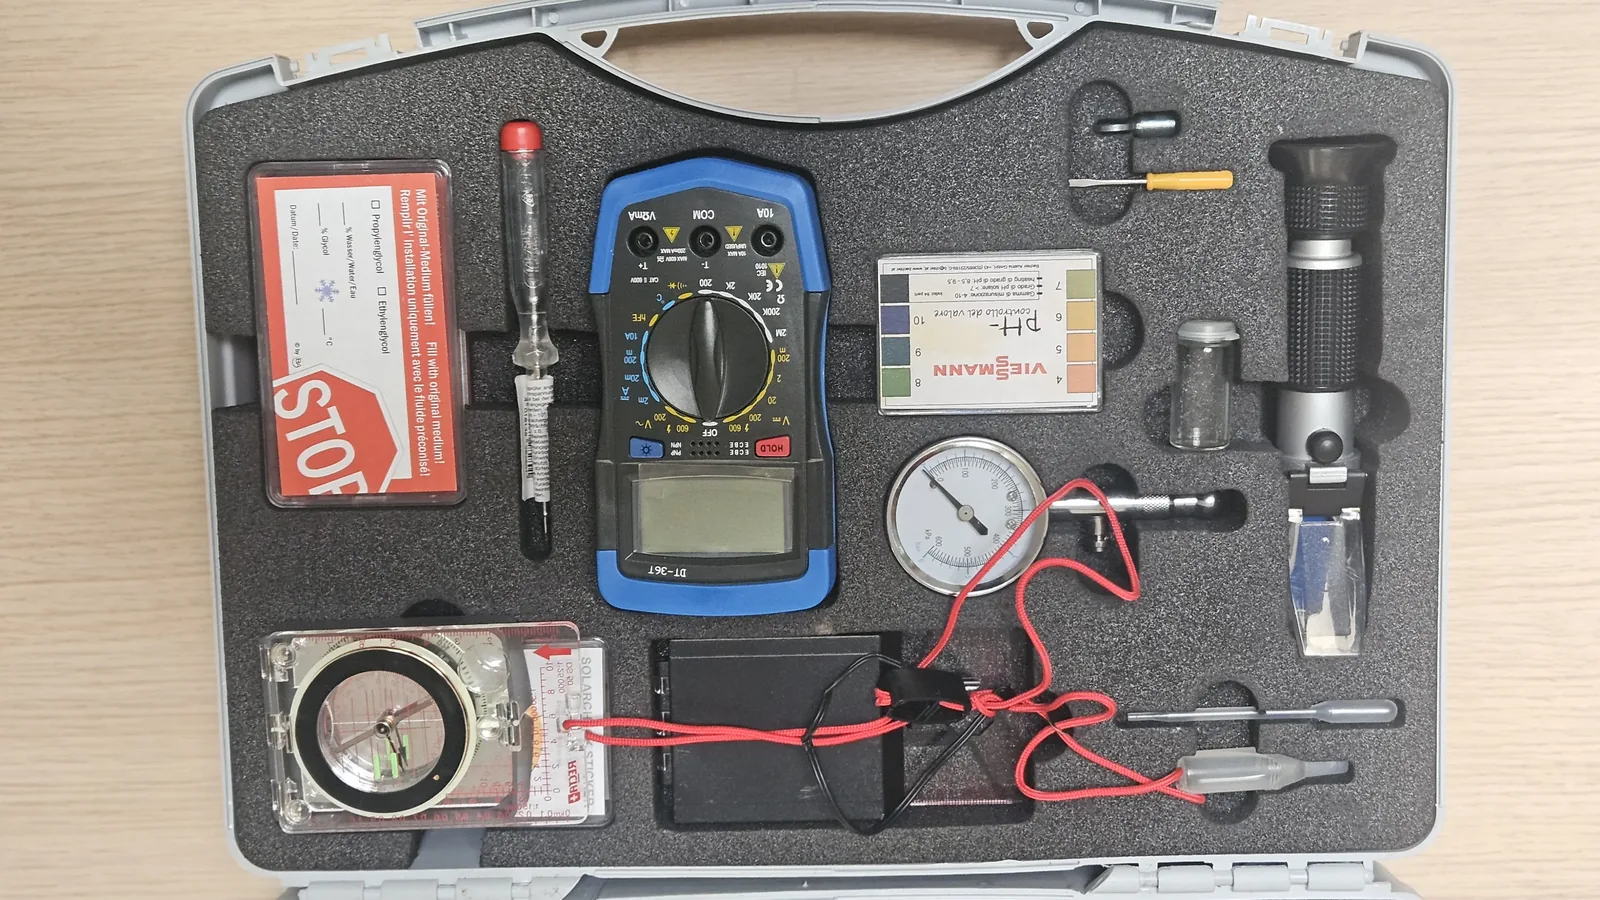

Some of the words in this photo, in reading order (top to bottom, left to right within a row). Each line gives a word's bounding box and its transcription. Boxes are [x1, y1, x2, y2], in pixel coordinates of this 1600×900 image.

[416, 189, 427, 204] Mit
[399, 190, 413, 229] Remplir
[693, 210, 714, 219] COM
[757, 208, 774, 218] 10A
[290, 205, 299, 249] Datum/Date:
[321, 236, 329, 255] Glycol
[372, 215, 384, 274] Propylenglycol
[416, 207, 431, 291] Original-Medium
[346, 235, 357, 298] Wasser/Water/Eau
[403, 240, 418, 295] installation
[1056, 282, 1061, 290] 7
[423, 294, 436, 325] füllen!
[934, 310, 964, 319] valore
[967, 310, 982, 318] del
[986, 308, 1030, 317] controllo
[914, 316, 925, 325] 10
[1056, 313, 1062, 321] 6
[377, 301, 390, 354] Ethylenglycol
[408, 298, 421, 357] uniquement
[625, 332, 637, 340] 10A
[776, 329, 786, 337] 2M
[427, 342, 438, 356] Fill
[916, 348, 921, 356] 9
[1056, 345, 1062, 354] 5
[624, 356, 636, 364] 200
[777, 354, 790, 362] 200
[412, 360, 422, 381] avec
[428, 359, 439, 378] with
[933, 356, 1046, 380] VIESSMANN
[915, 378, 921, 387] 8
[1056, 376, 1062, 384] 4
[414, 384, 423, 392] le
[428, 382, 442, 418] original
[414, 396, 426, 423] fluide
[654, 413, 666, 421] 200
[729, 424, 741, 432] 600
[433, 421, 445, 464] medium!
[415, 426, 430, 476] préconisé!
[760, 444, 783, 452] HOLD
[648, 566, 686, 577] DT-36T
